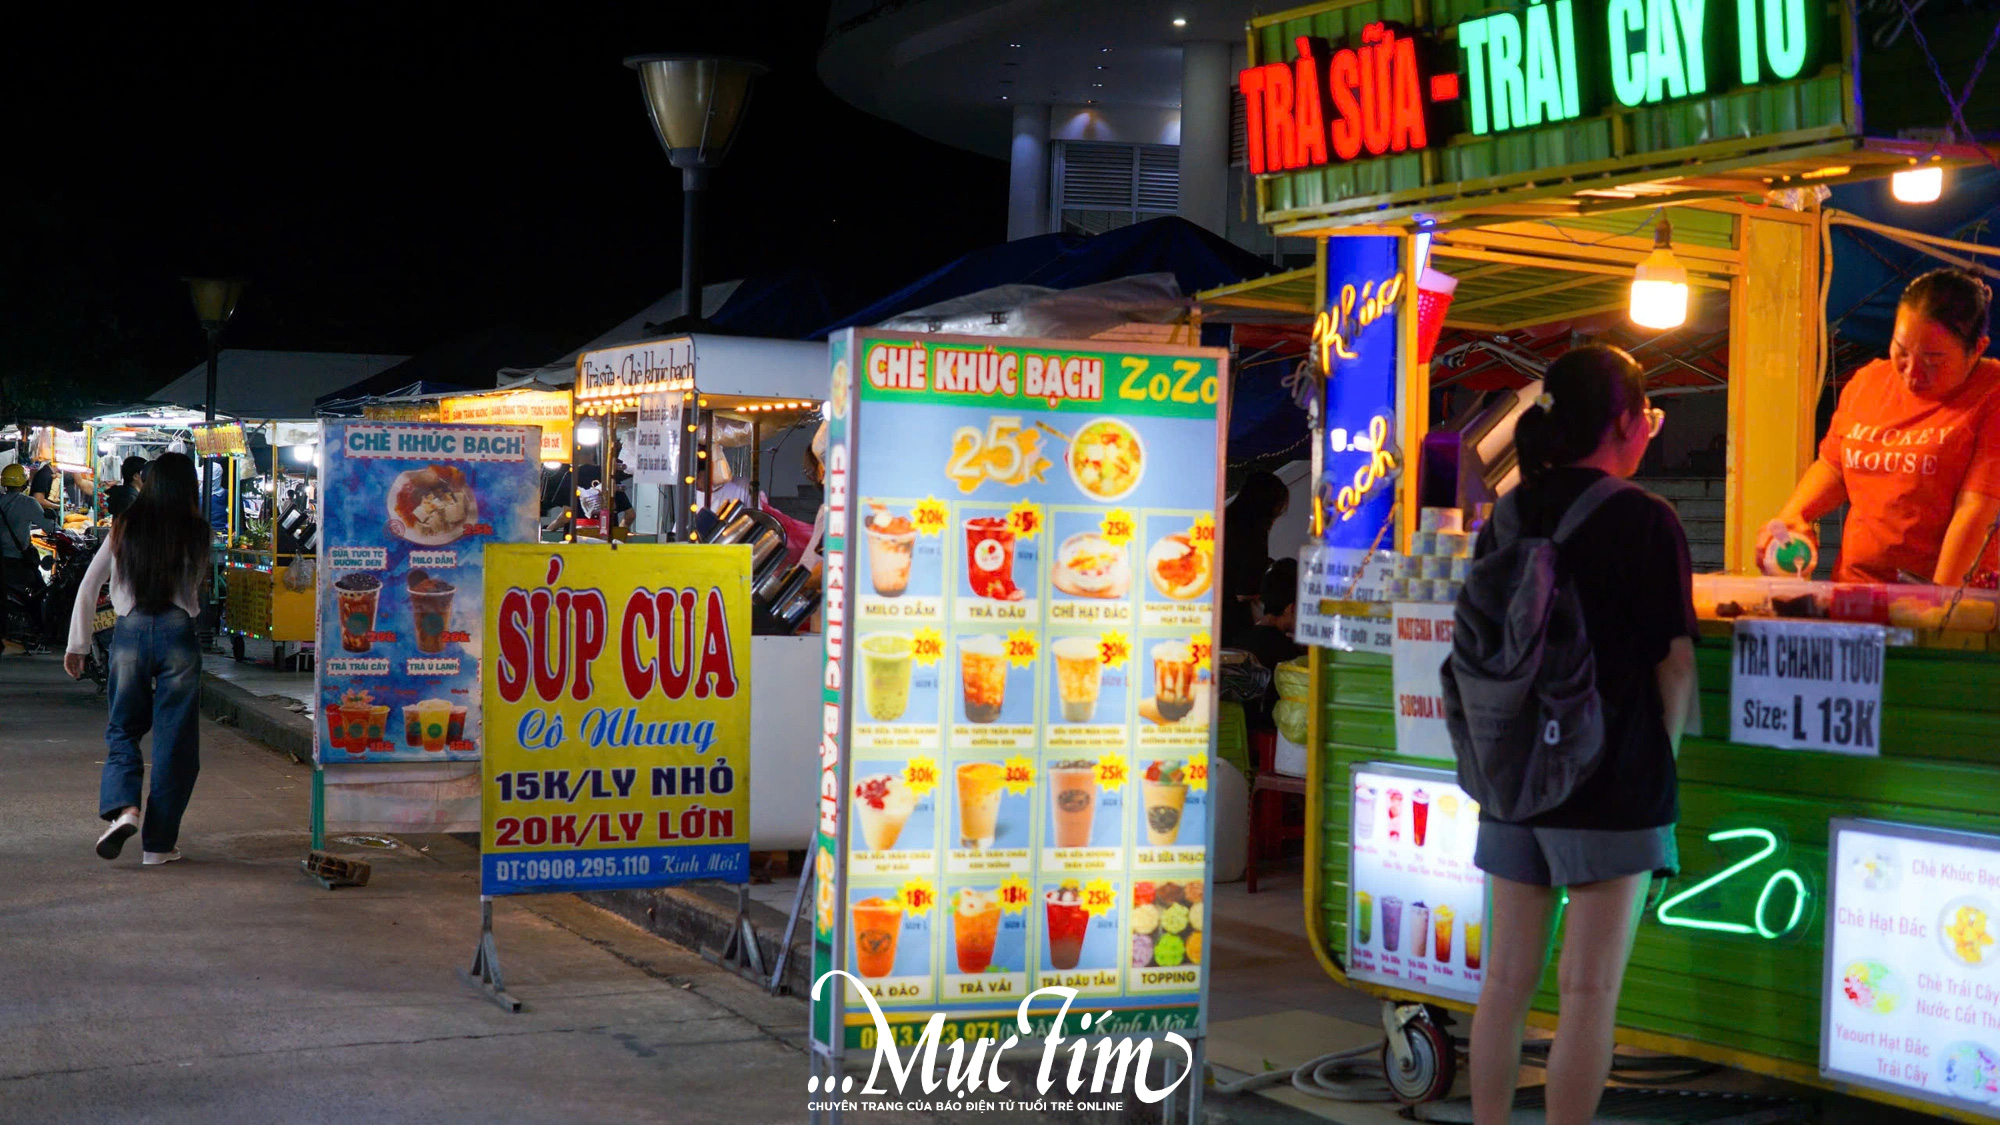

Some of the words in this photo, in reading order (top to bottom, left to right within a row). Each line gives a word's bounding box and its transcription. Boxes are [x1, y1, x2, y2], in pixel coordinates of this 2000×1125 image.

[1239, 34, 1328, 175] TRÀ
[1329, 20, 1428, 160] SỮA
[584, 361, 599, 389] Trà
[622, 353, 643, 386] Chè
[867, 341, 928, 391] CHÈ
[934, 345, 1018, 396] KHÚC
[1024, 355, 1104, 409] BẠCH
[349, 429, 391, 451] CHÈ
[398, 431, 457, 453] KHÚC
[463, 436, 521, 458] BẠCH
[1847, 422, 1954, 447] MICKEY
[1845, 448, 1937, 475] MOUSE
[412, 556, 433, 565] MILO
[865, 603, 899, 615] MILO
[969, 603, 994, 618] TRÀ
[497, 553, 608, 704] SÚP
[620, 586, 739, 701] CUA
[1737, 627, 1770, 677] TRÀ
[1775, 633, 1834, 681] CHANH
[518, 708, 567, 750] Cô
[580, 707, 718, 754] Nhung
[1743, 698, 1787, 731] Size:
[1793, 695, 1806, 740] L
[1817, 696, 1875, 748] 13K
[494, 767, 637, 802] 15K/LY
[652, 758, 734, 796] NHỎ
[495, 812, 645, 847] 20K/LY
[658, 805, 734, 840] LỚN
[496, 855, 650, 881] ĐT:0908.295.110
[1912, 857, 1937, 878] Chè
[1941, 863, 1975, 884] Khúc
[1838, 906, 1865, 928] Chè
[1870, 911, 1894, 937] Hạt
[1900, 914, 1927, 939] Đác
[860, 982, 884, 998] RÀ
[889, 982, 920, 997] ĐÀO
[960, 980, 985, 994] TRÀ
[1141, 971, 1197, 984] TOPPING
[1918, 972, 1942, 992] Chè
[1947, 977, 1971, 998] Trái
[1975, 982, 2000, 1007] Cây
[1916, 998, 1951, 1020] Nước
[1955, 1003, 1977, 1025] Cốt
[1835, 1023, 1876, 1047] Yaourt
[1879, 1033, 1901, 1054] Hạt
[1877, 1057, 1901, 1077] Trái
[1904, 1063, 1929, 1087] Cây
